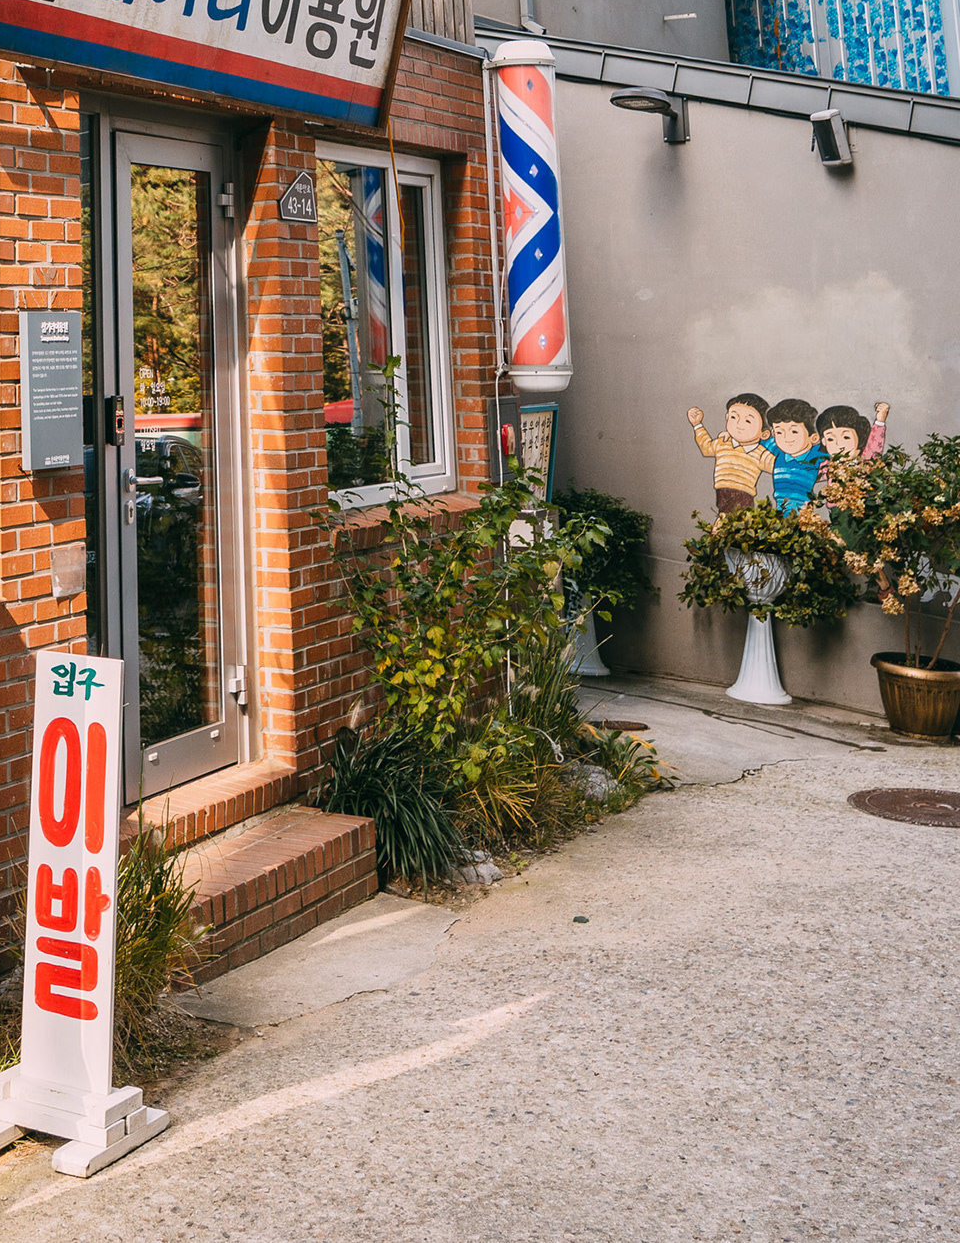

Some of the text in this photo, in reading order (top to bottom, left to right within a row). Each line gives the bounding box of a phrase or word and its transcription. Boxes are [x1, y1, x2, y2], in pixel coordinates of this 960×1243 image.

[287, 196, 313, 216] 43-14
[139, 367, 154, 379] OPEN
[150, 381, 166, 395] 일요일
[50, 661, 105, 701] 입구
[34, 718, 112, 1021] 이발
